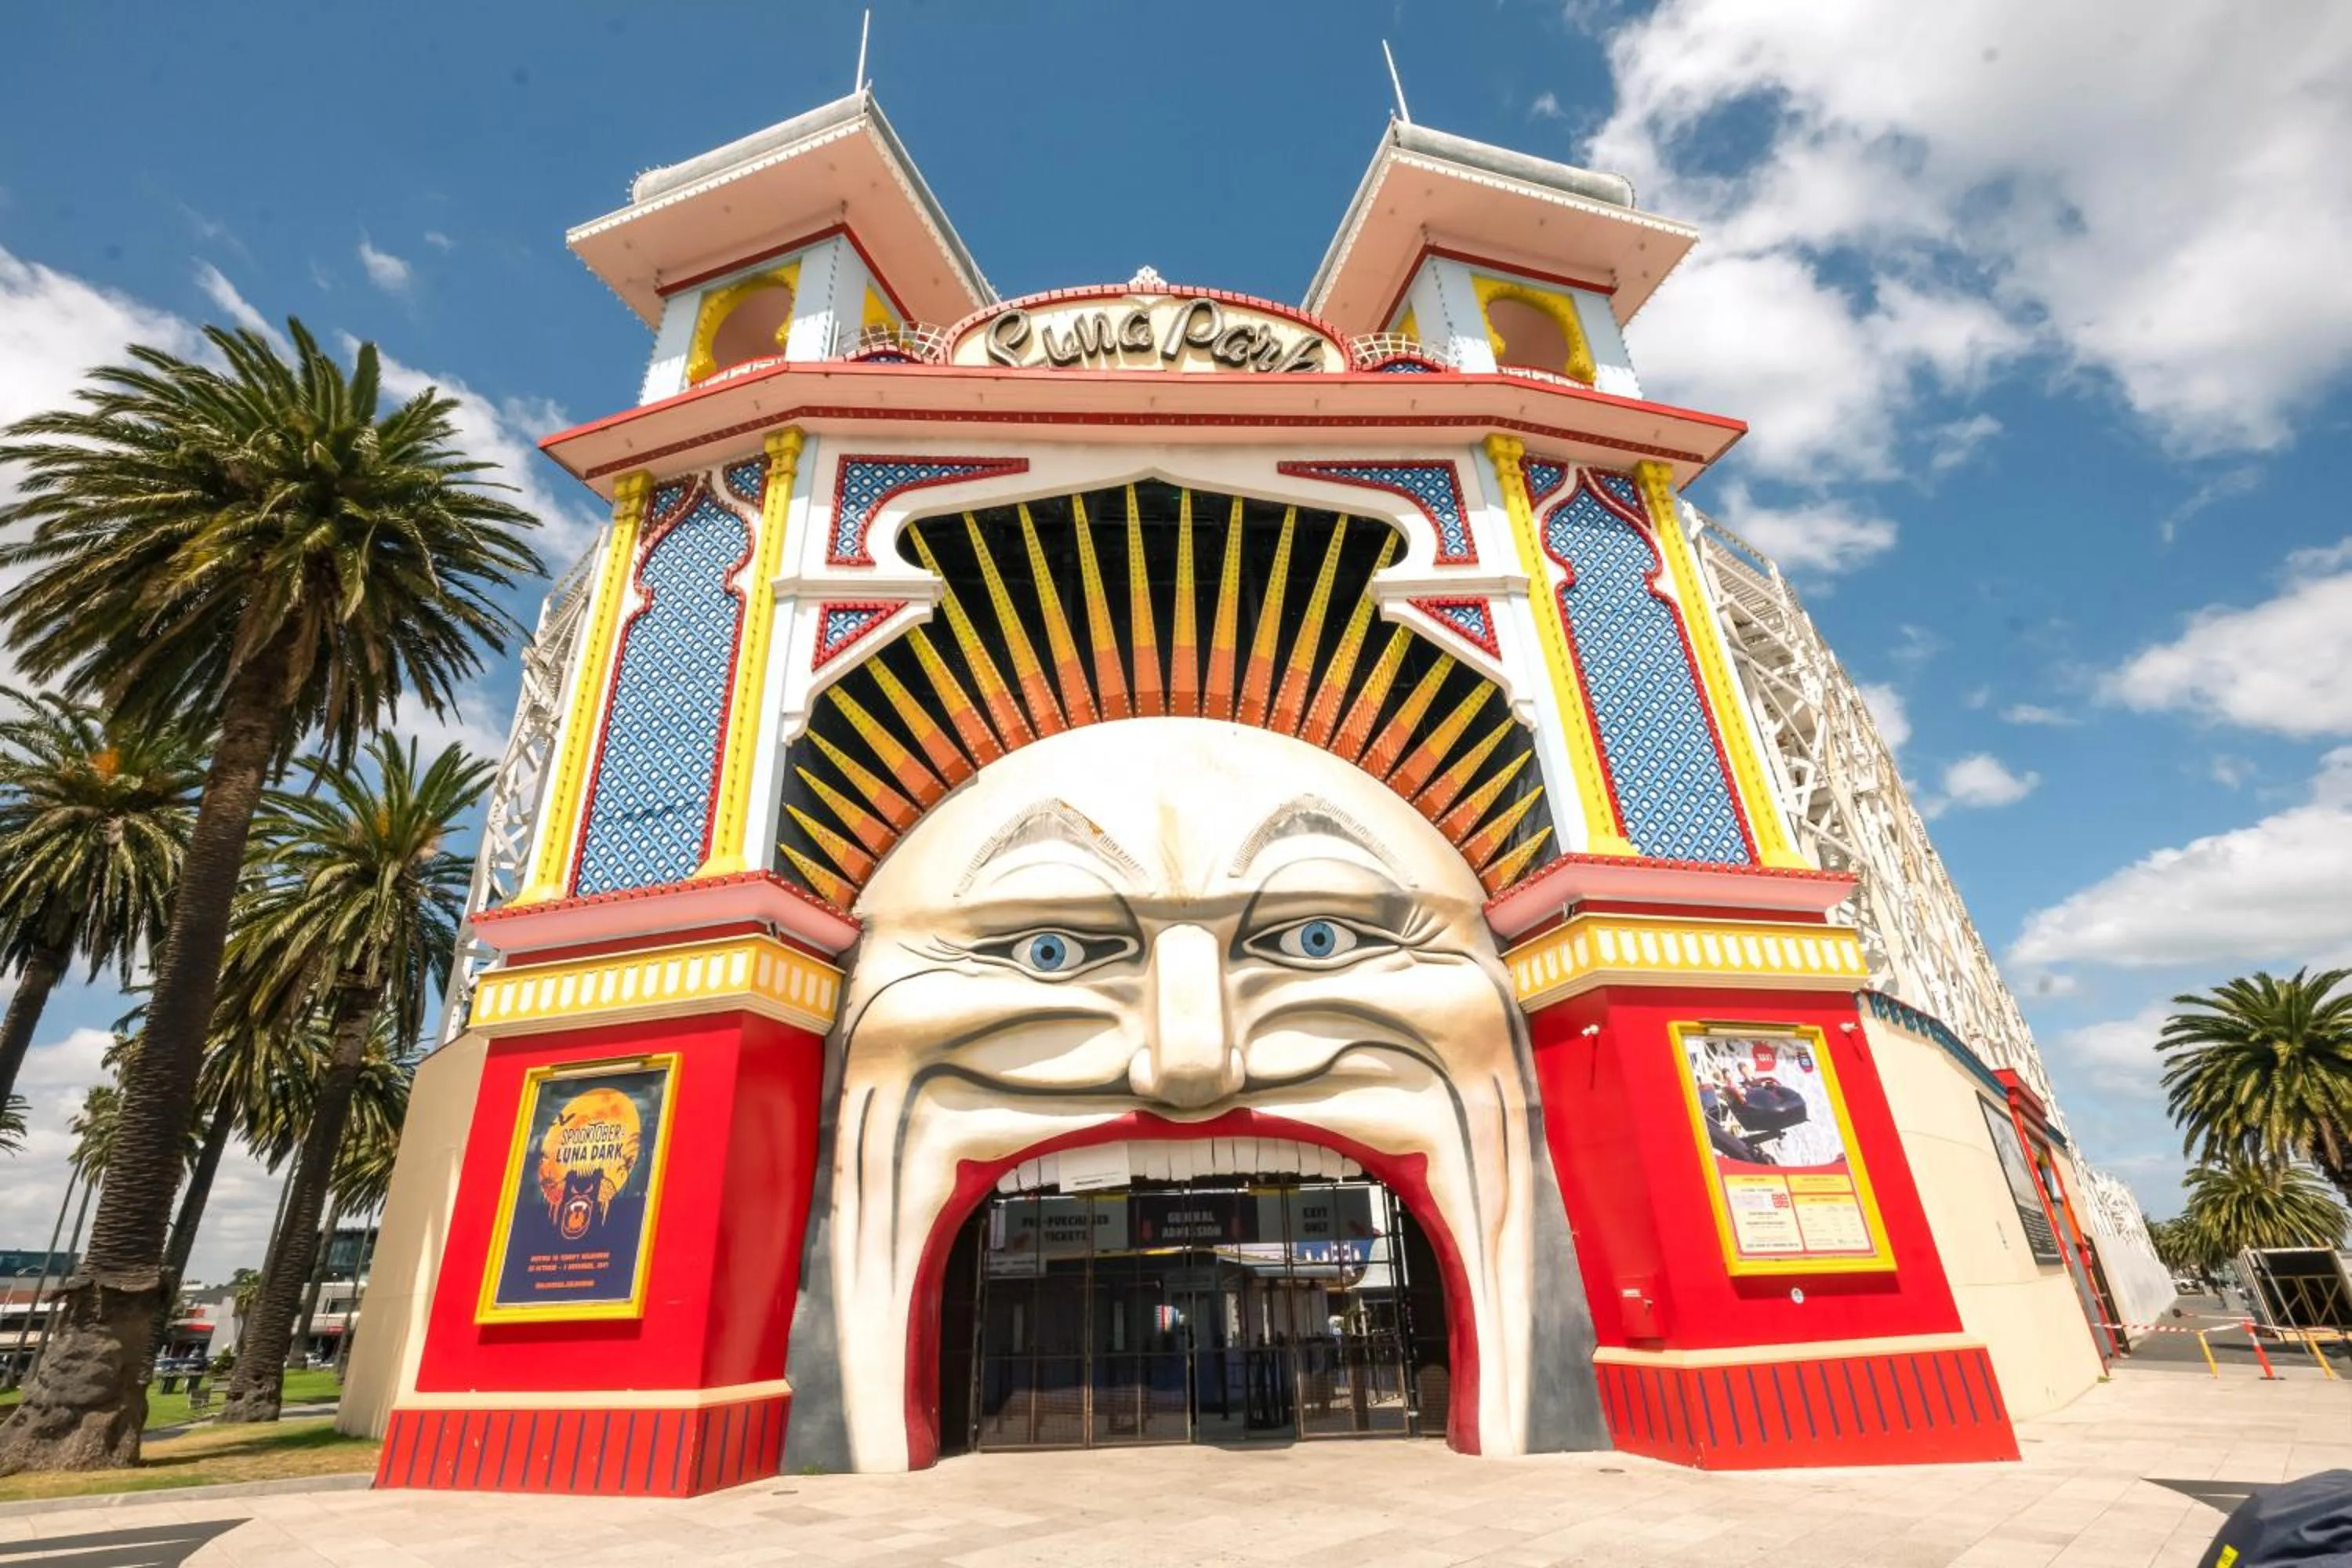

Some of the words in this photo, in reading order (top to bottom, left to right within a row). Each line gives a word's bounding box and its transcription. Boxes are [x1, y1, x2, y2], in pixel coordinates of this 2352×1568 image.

[985, 308, 1154, 367] Luna
[1160, 297, 1325, 372] Park
[557, 1145, 586, 1163] LUNA
[591, 1143, 622, 1160] DARK
